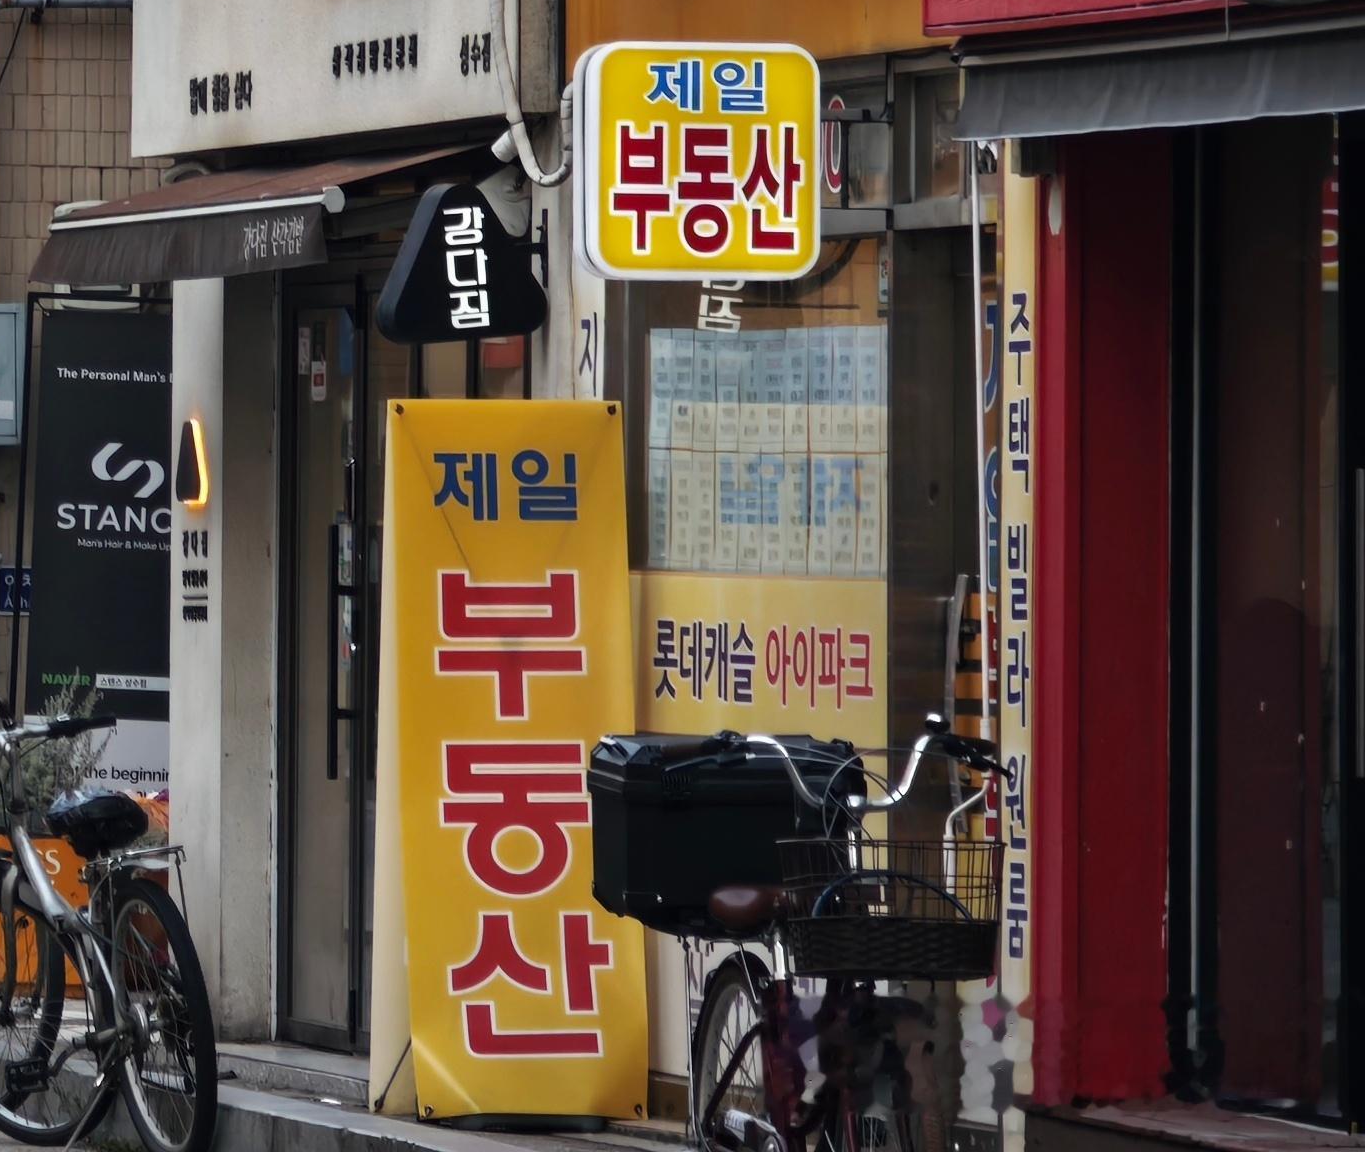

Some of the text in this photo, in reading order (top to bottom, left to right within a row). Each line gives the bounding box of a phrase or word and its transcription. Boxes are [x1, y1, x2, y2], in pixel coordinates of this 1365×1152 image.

[646, 59, 768, 116] 제일
[612, 121, 804, 256] 부동산
[442, 206, 492, 331] 강다짐
[57, 367, 166, 383] The Personal Man's
[56, 503, 171, 534] STANC
[433, 450, 578, 524] 제일
[652, 619, 875, 710] 롯데캐슬 아이파크
[1006, 292, 1031, 960] 주택 빌라 원룸
[42, 673, 91, 686] NAVER
[434, 570, 612, 1059] 부동산
